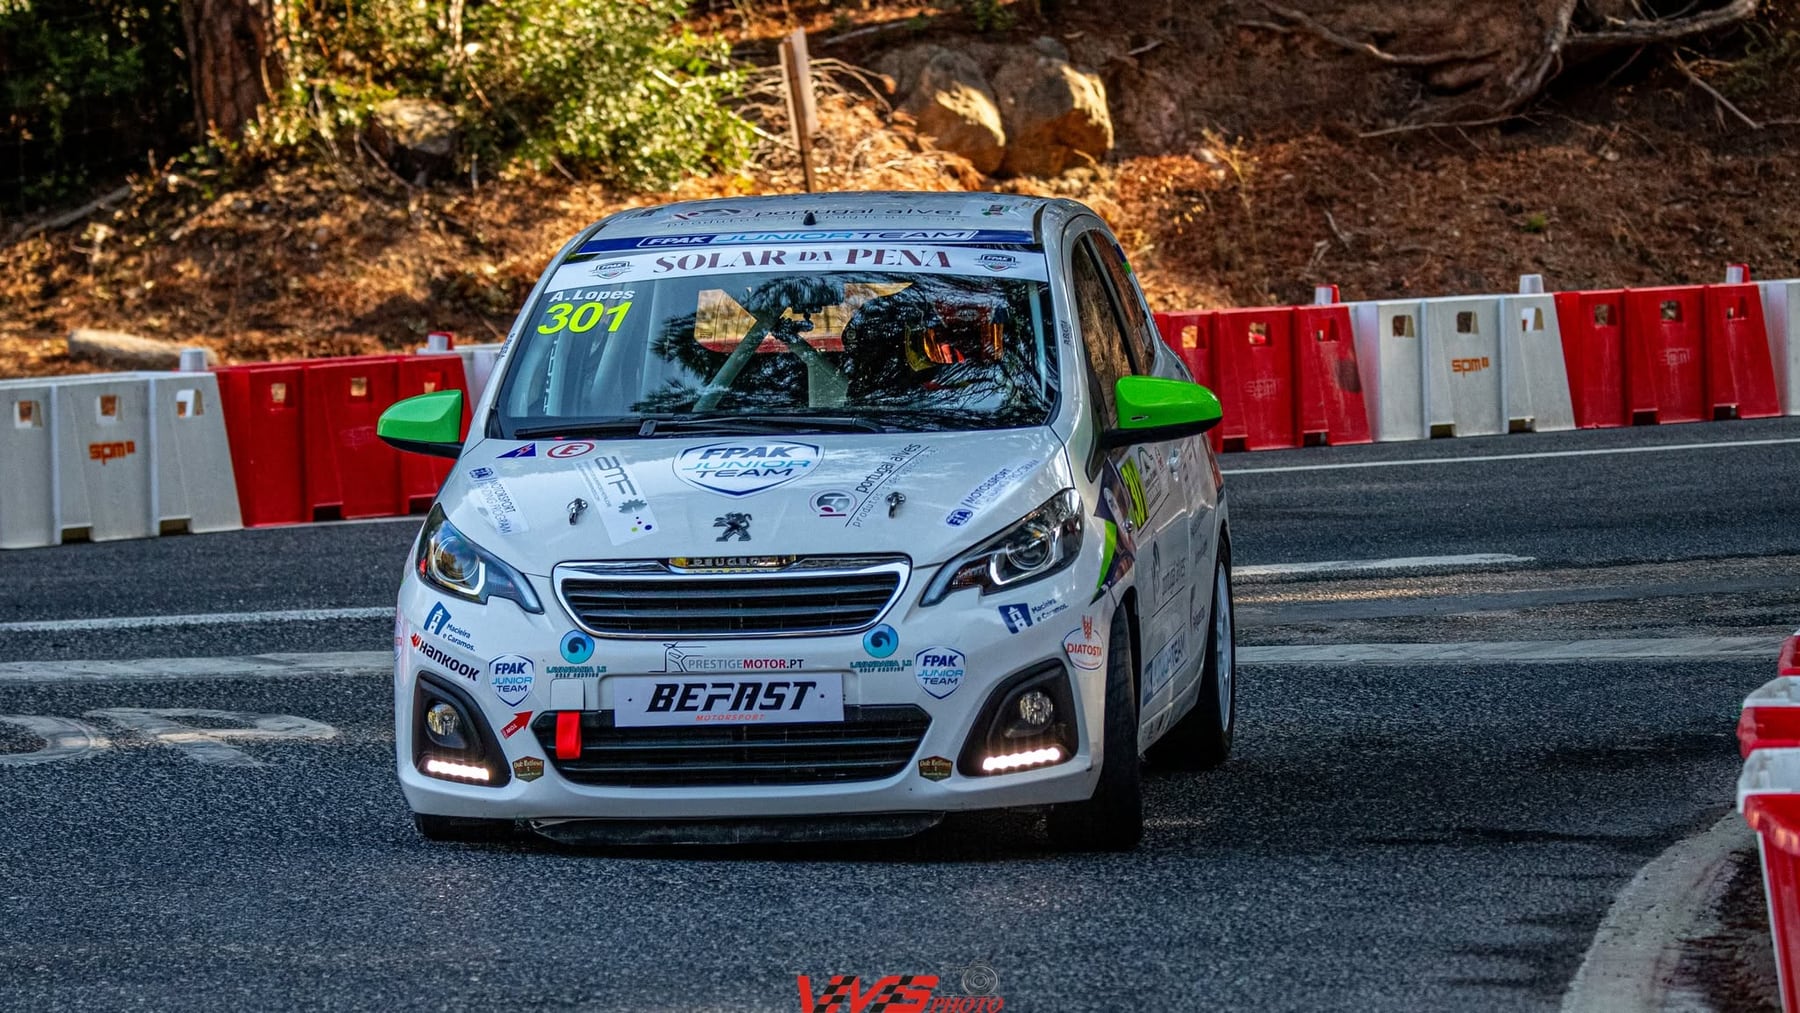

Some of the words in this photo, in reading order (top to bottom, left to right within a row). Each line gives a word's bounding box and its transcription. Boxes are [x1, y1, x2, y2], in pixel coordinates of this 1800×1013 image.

[650, 236, 706, 245] FPAK
[653, 249, 787, 274] SOLAR
[798, 251, 832, 262] DA
[845, 249, 952, 268] PENA
[550, 289, 636, 302] A.Lopes
[537, 301, 633, 335] 301
[700, 446, 799, 460] FPAK
[682, 460, 810, 470] JUNIOR
[855, 461, 894, 494] portugal
[892, 442, 922, 464] alves
[696, 468, 793, 478] TEAM
[447, 623, 471, 639] Macieira
[688, 658, 804, 669] PRESTIGEMOTOR.PT
[922, 655, 958, 667] FPAK
[495, 662, 527, 675] FPAK
[917, 669, 964, 677] JUNIOR
[492, 677, 532, 685] JUNIOR
[922, 677, 958, 685] TEAM
[646, 681, 817, 713] BEFAST
